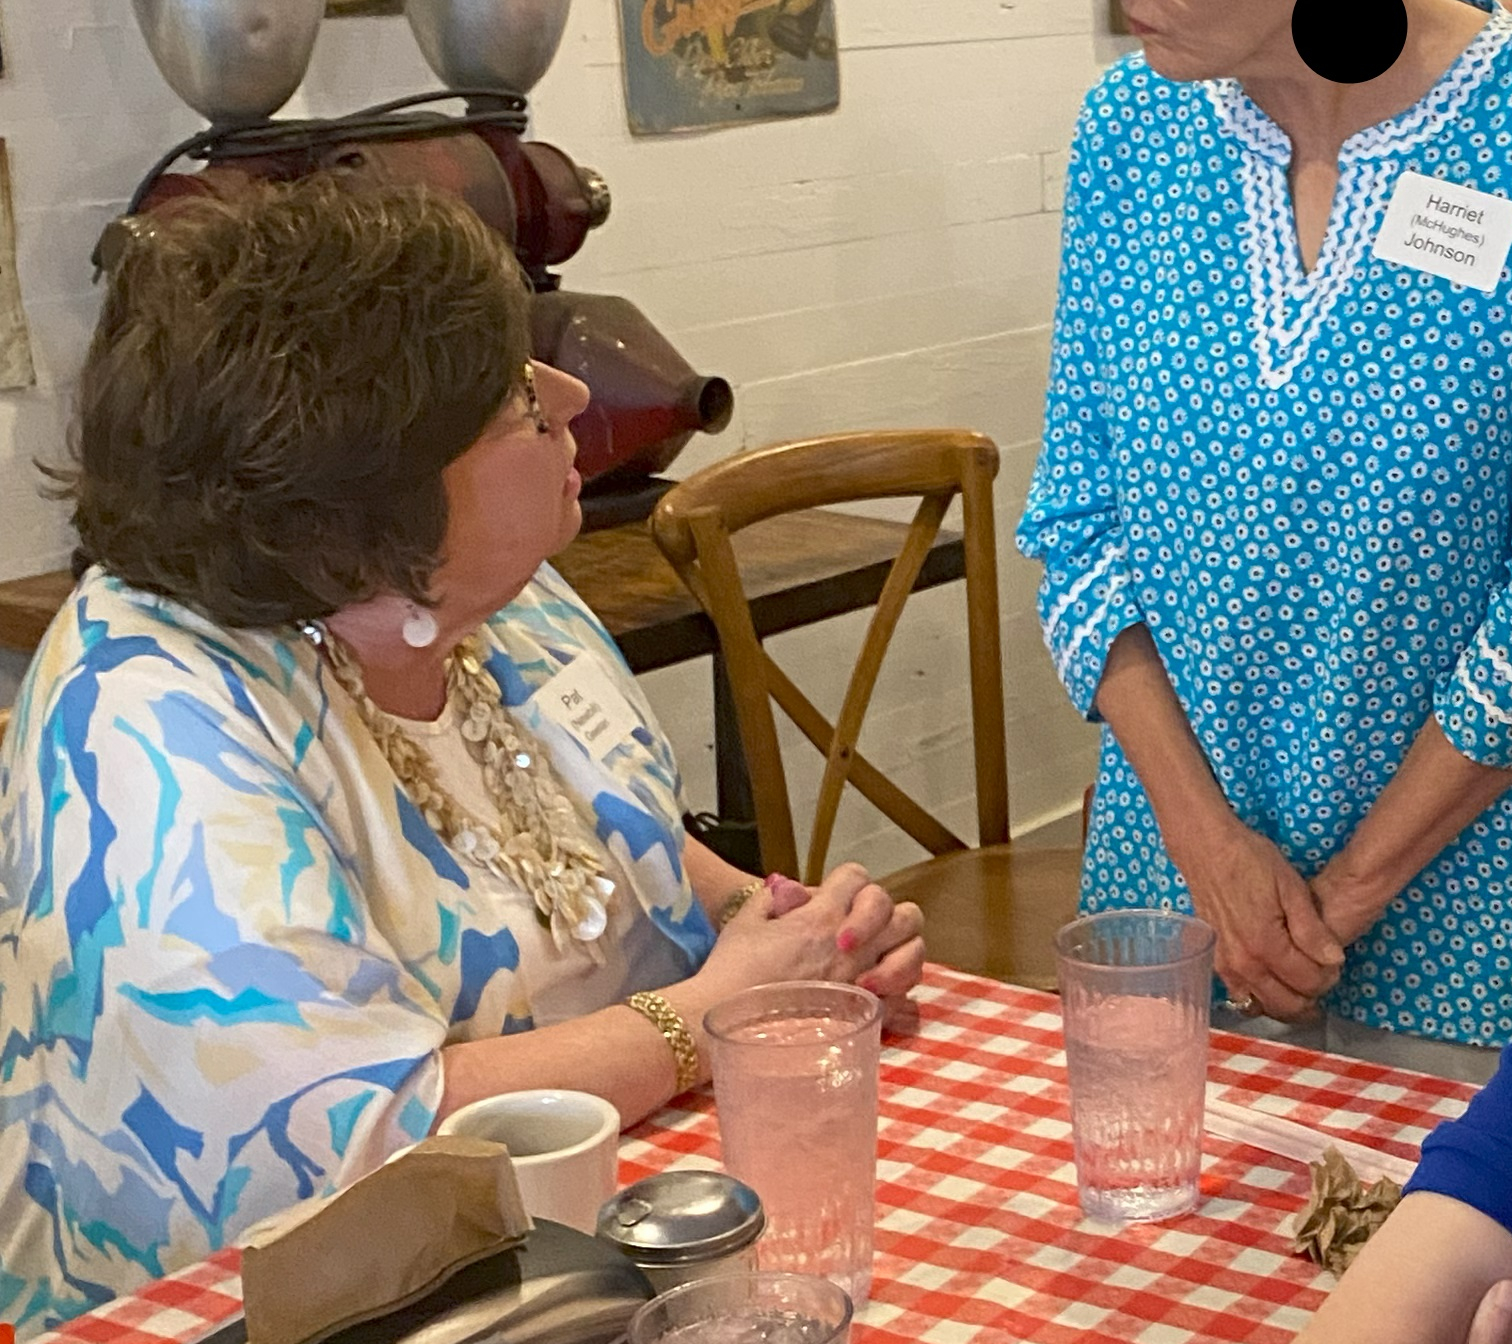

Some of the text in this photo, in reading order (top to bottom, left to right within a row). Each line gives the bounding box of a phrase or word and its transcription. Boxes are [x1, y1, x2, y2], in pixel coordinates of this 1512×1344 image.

[1425, 193, 1485, 225] Harriet
[1410, 213, 1486, 248] (McHughes)
[1403, 232, 1477, 267] Johnson
